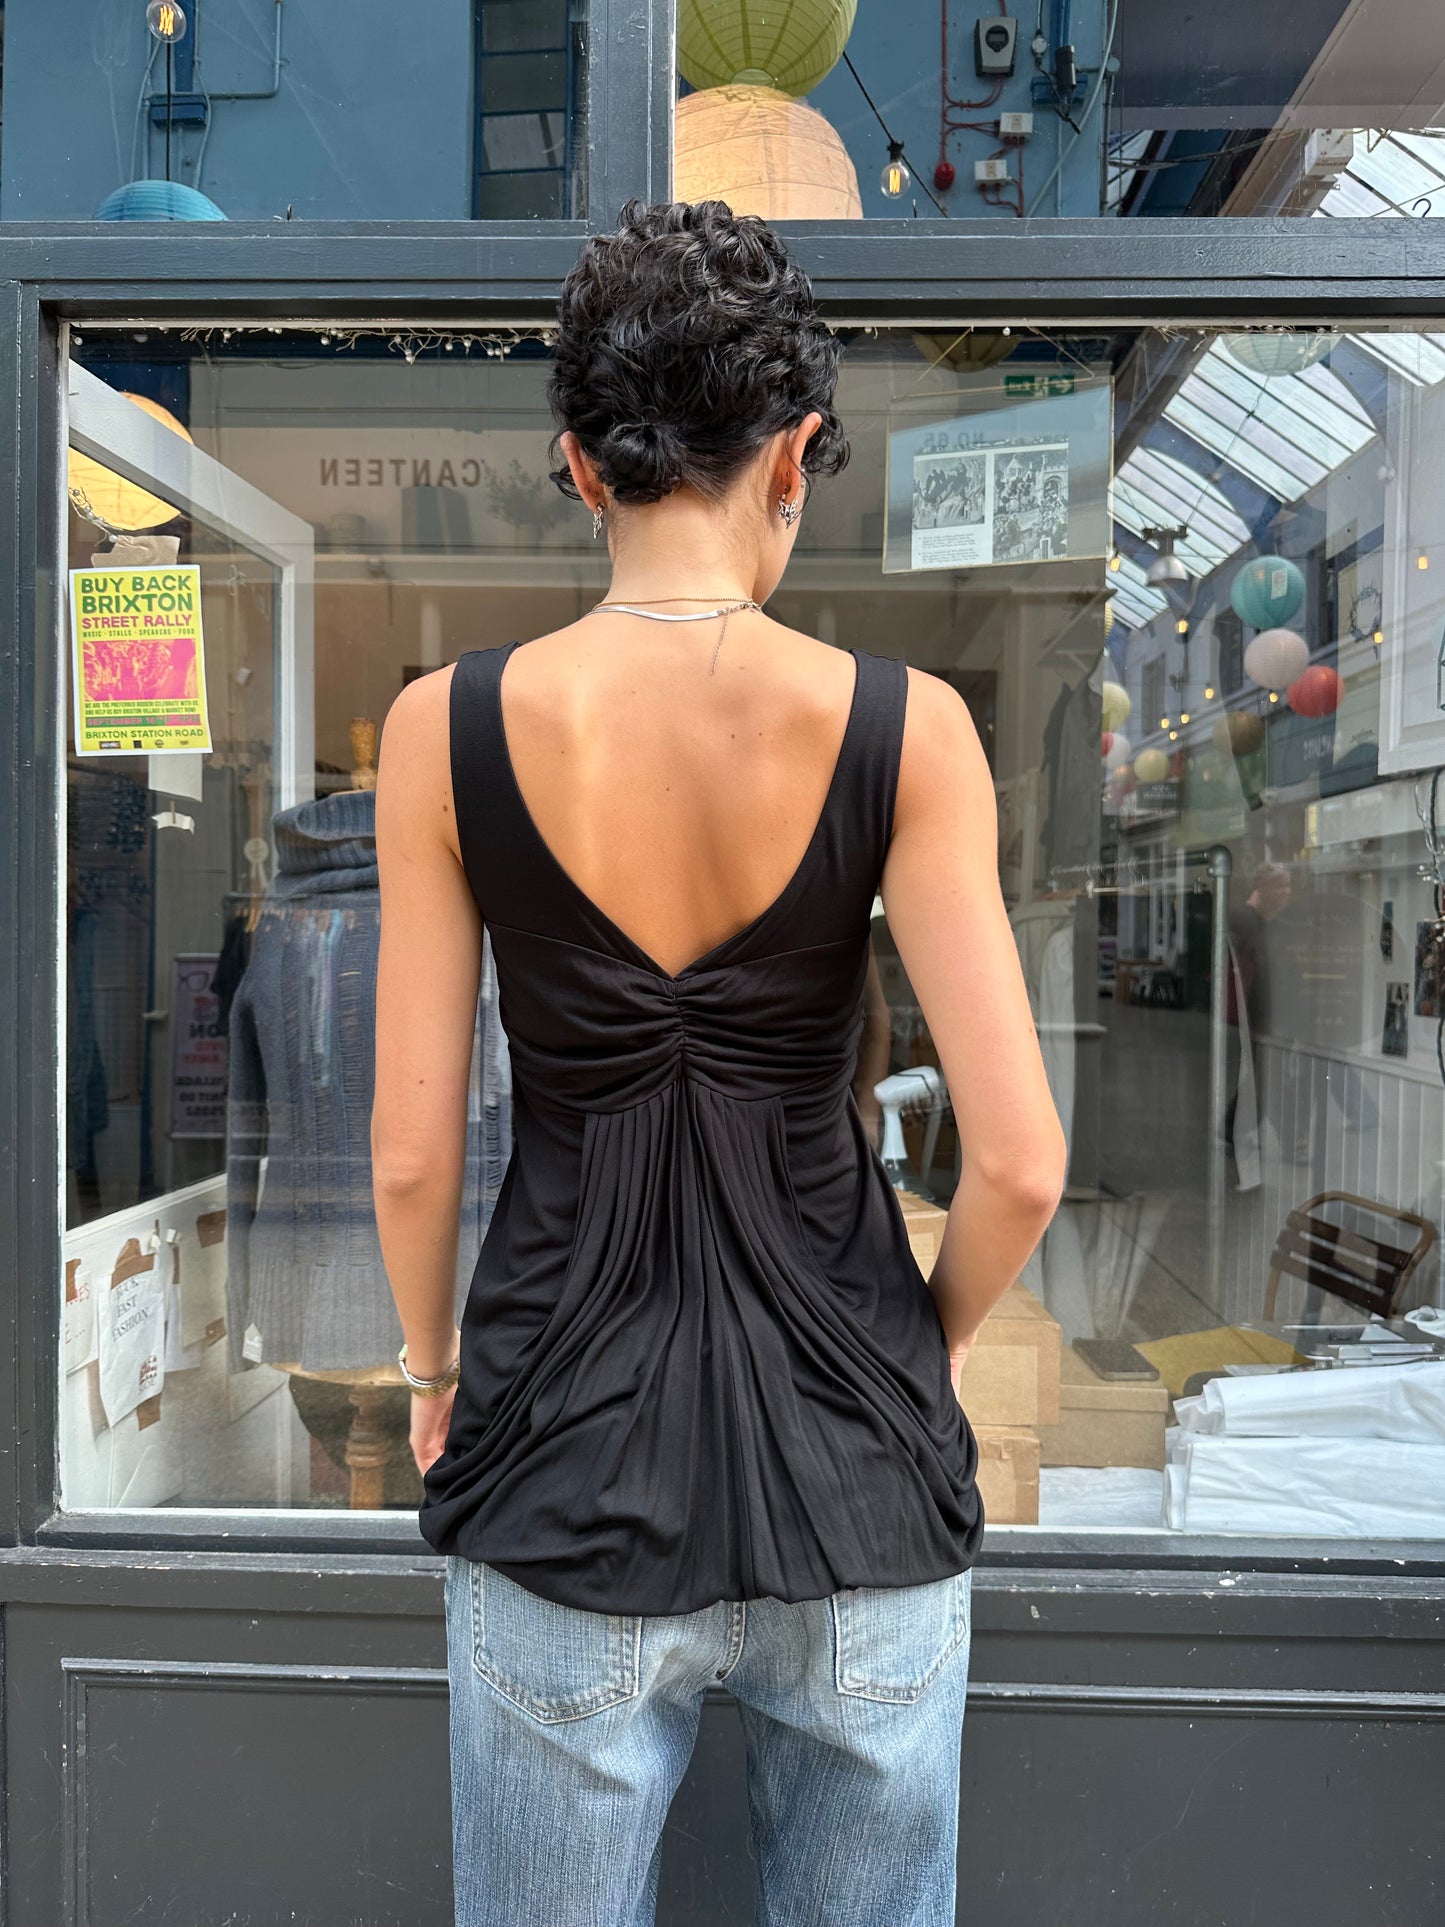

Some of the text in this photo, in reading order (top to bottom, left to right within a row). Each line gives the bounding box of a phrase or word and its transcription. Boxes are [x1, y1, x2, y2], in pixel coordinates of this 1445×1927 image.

[81, 575, 192, 594] BUY BACK
[82, 592, 193, 614] BRIXTON
[82, 614, 192, 629] STREET RALLY
[82, 630, 102, 638] MUSIC
[109, 629, 132, 637] STALLS
[139, 628, 171, 636] SPEAKERS
[87, 717, 142, 726] SEPTEMBER
[86, 729, 203, 739] BRIXTON STATION ROAD
[117, 1294, 138, 1318] FAST
